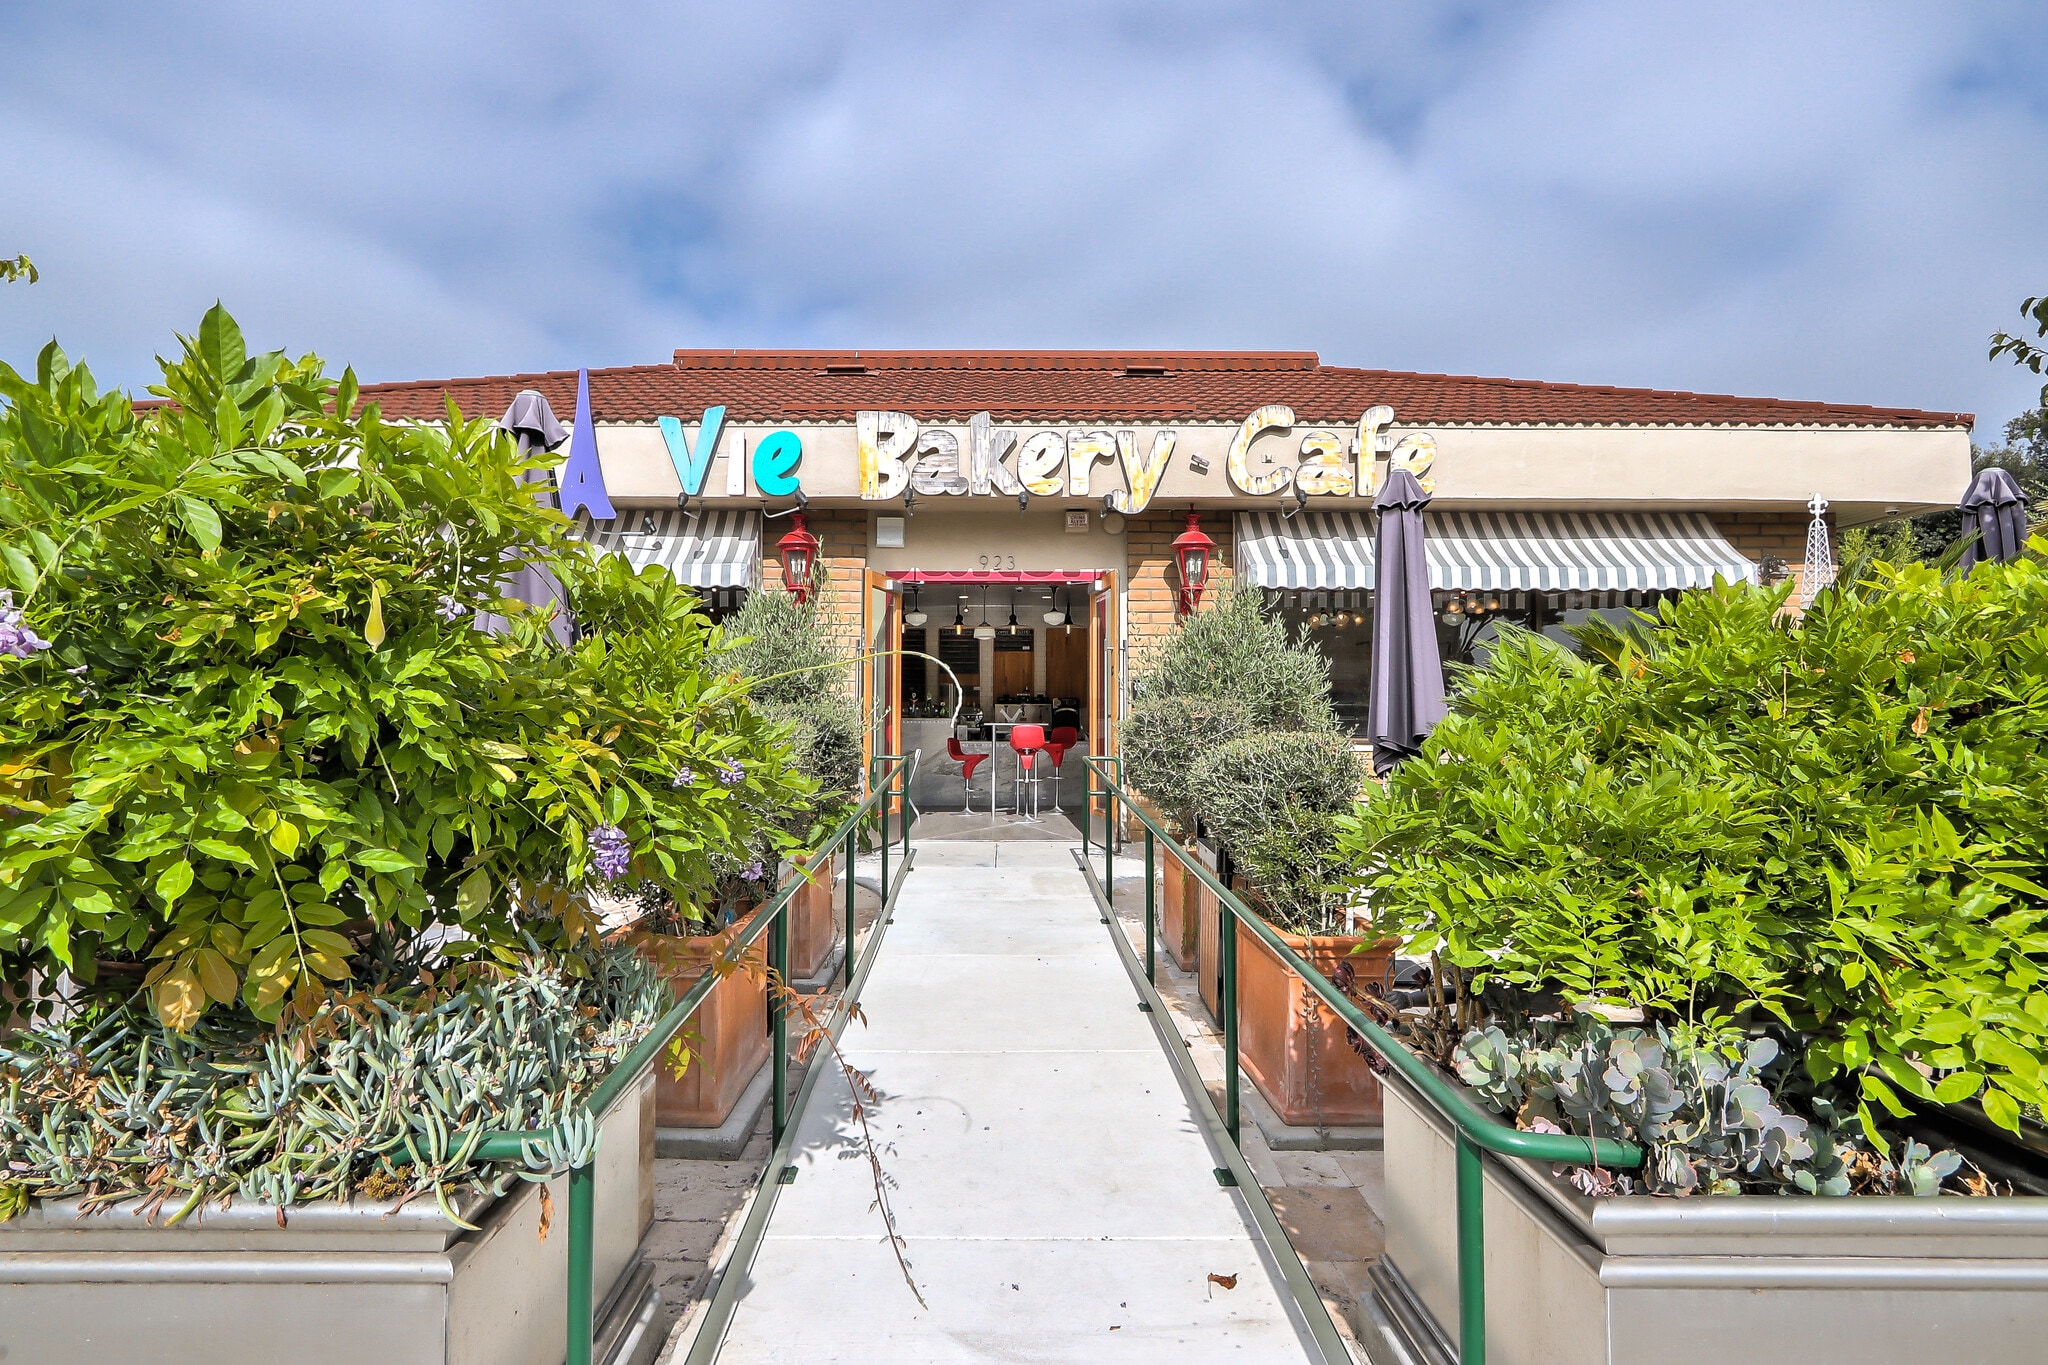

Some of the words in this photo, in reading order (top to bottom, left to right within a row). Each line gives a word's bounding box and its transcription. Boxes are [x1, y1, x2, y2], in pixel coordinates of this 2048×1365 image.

[560, 368, 617, 519] A
[856, 411, 1177, 514] Bakery
[1228, 405, 1437, 496] Cafe
[979, 555, 1016, 571] 923
